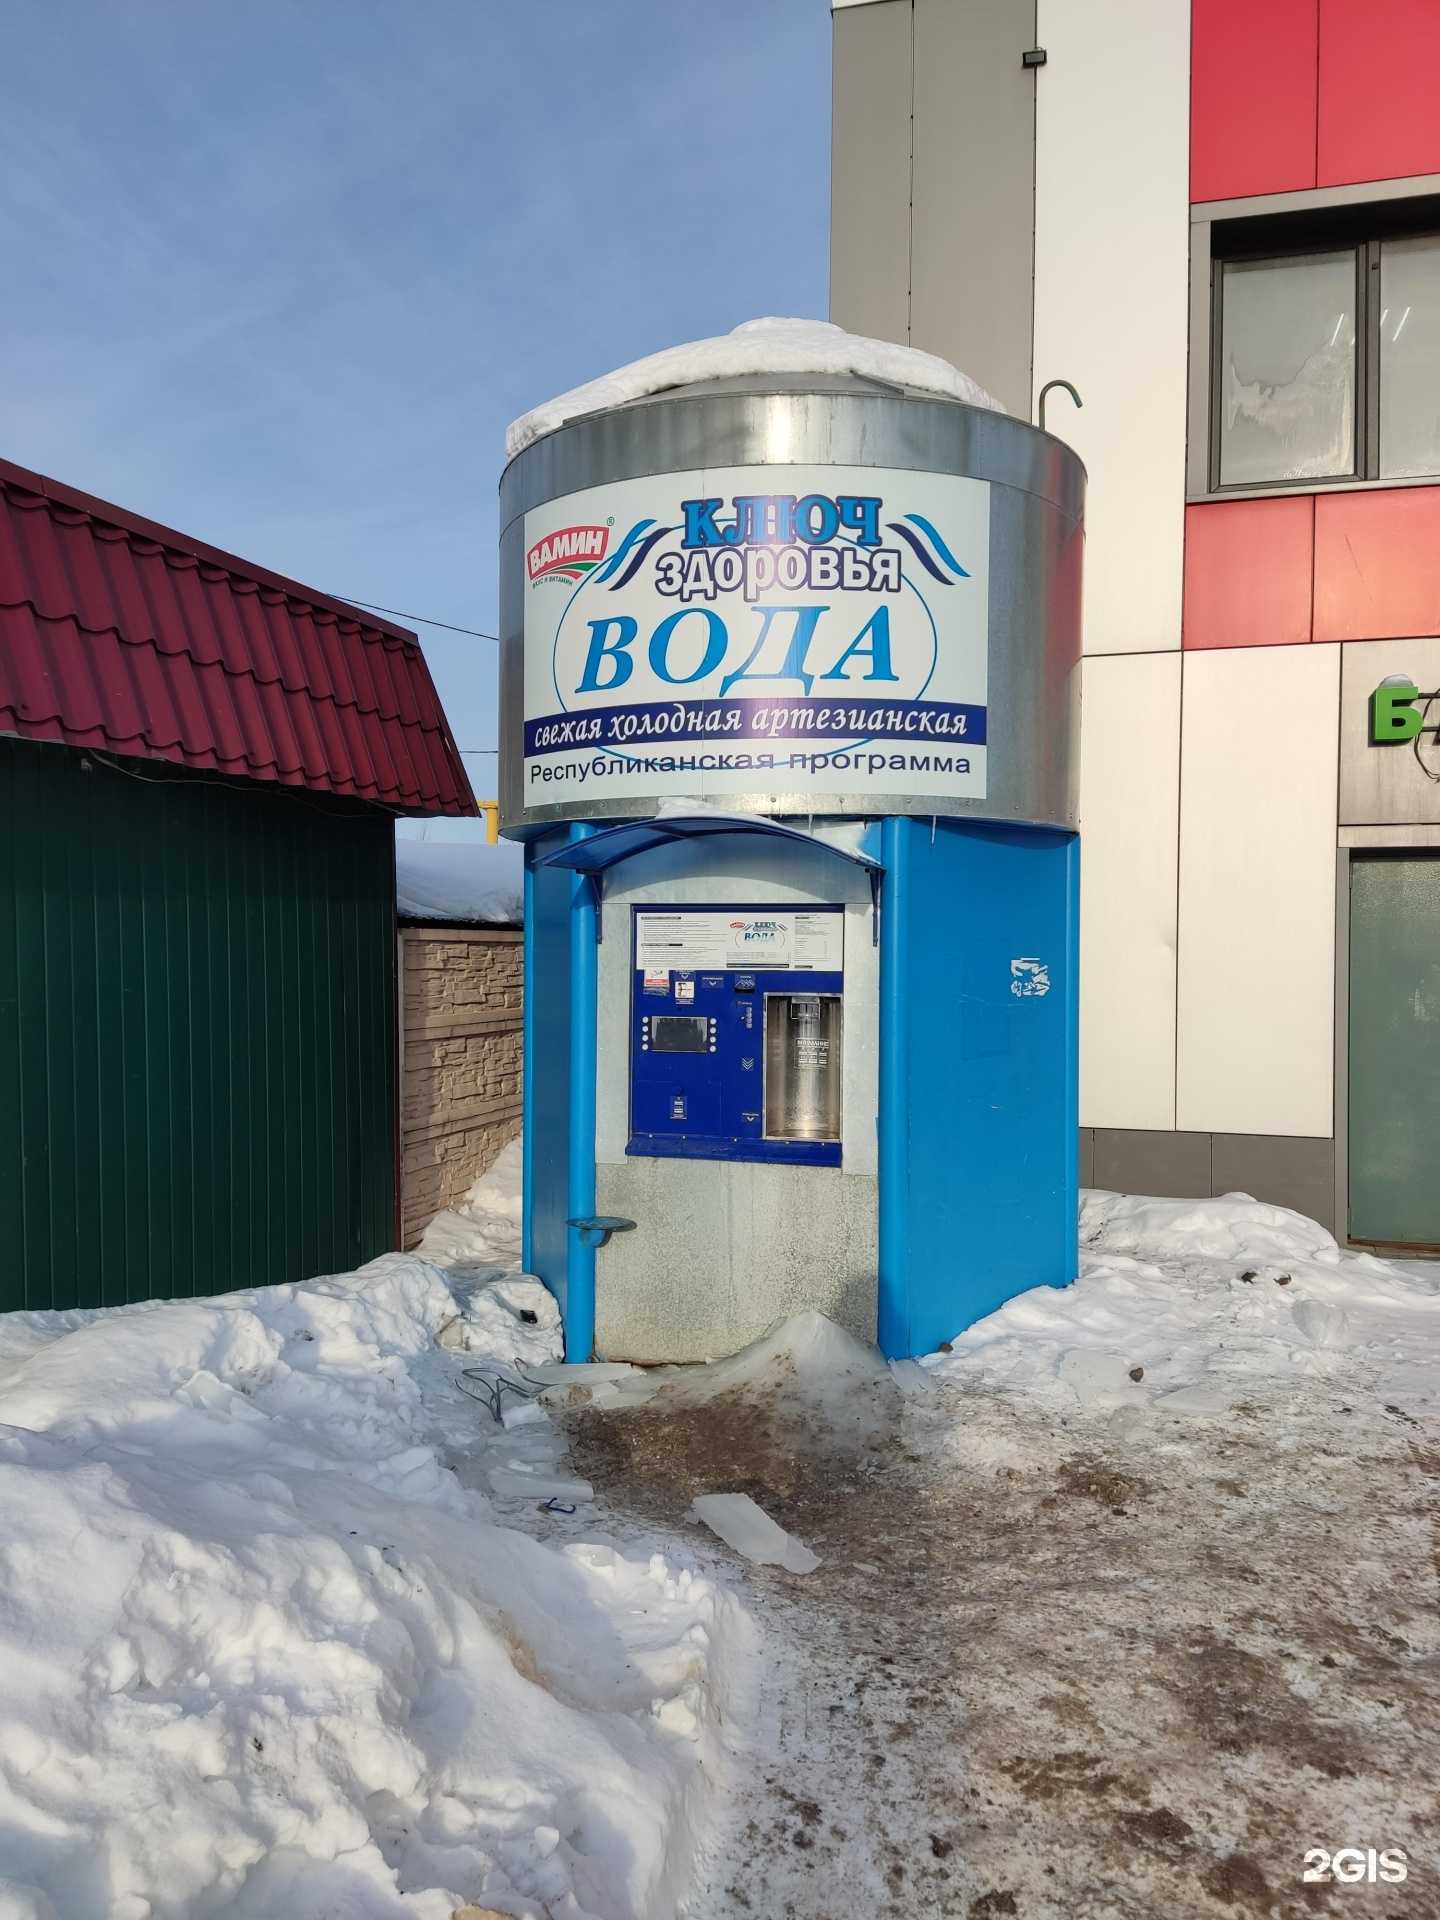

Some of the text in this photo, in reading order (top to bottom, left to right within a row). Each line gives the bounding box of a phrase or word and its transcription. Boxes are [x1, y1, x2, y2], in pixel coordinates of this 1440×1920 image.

[682, 495, 882, 547] КЛЮЧ
[530, 530, 604, 574] ВАМИН
[655, 546, 901, 602] ЗДОРОВЬЯ
[575, 605, 900, 698] ВОДА
[535, 704, 967, 747] свежая холодная артезианская
[531, 754, 971, 784] Республиканская программа
